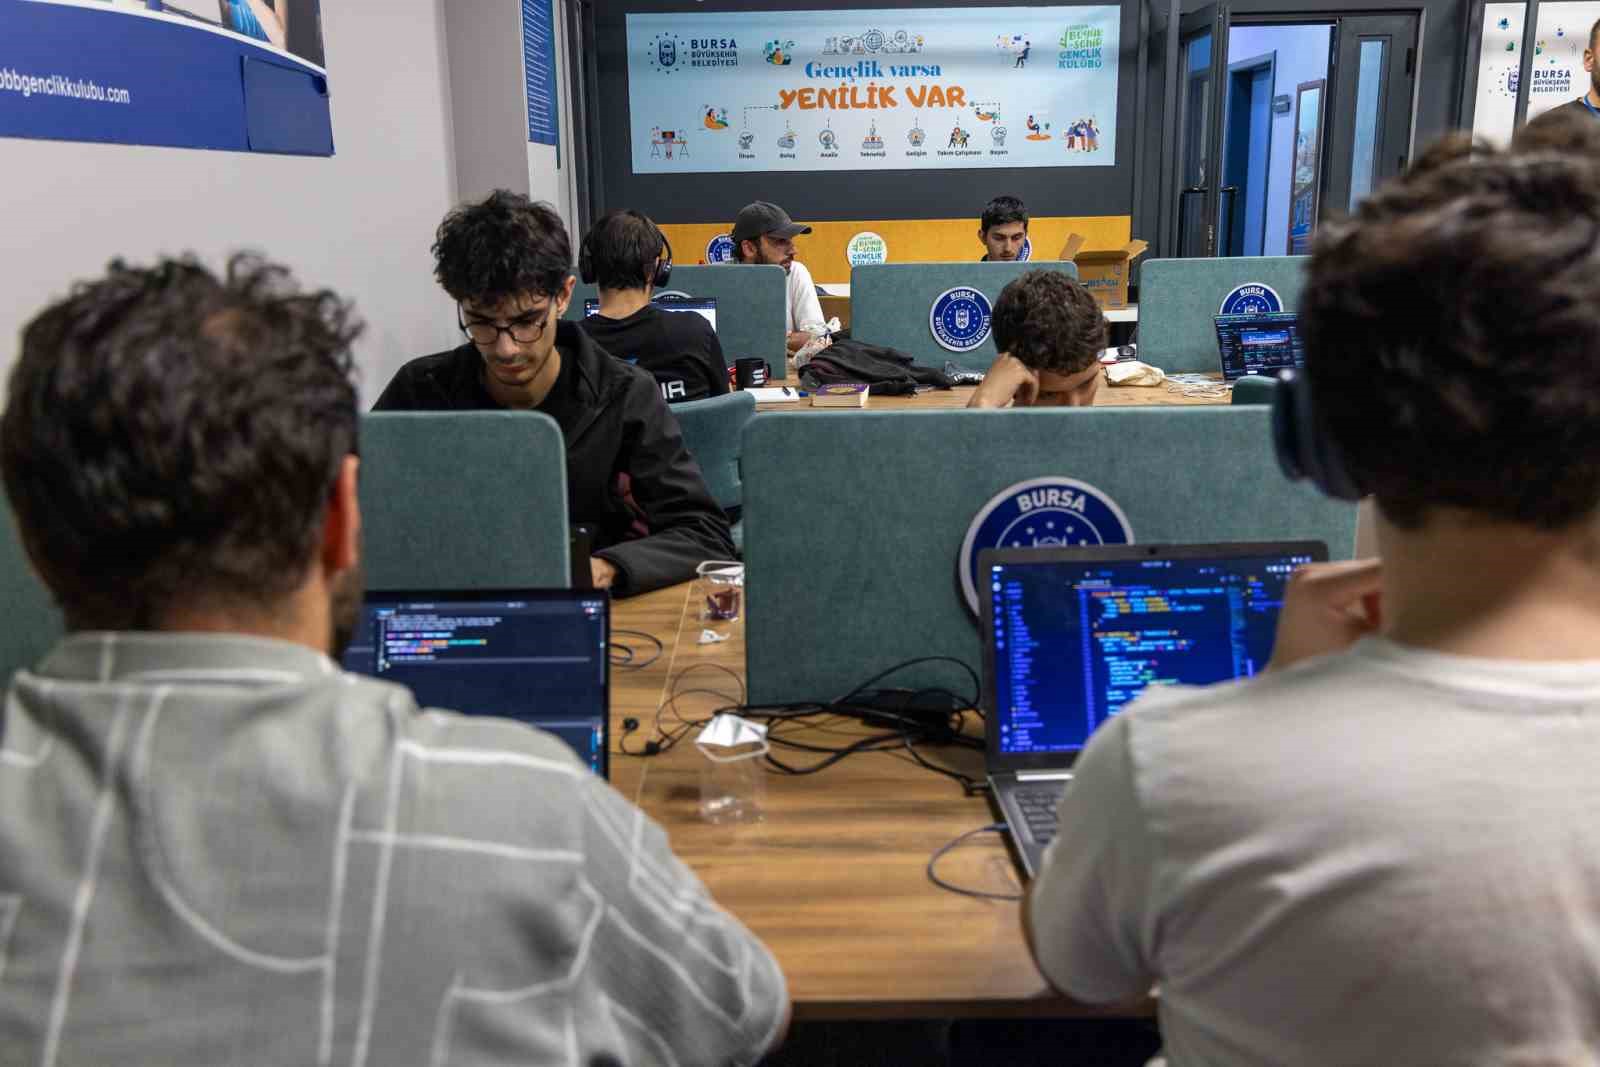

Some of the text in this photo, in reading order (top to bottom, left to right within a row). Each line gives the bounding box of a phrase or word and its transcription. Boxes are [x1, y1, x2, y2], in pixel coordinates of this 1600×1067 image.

[691, 39, 737, 49] BURSA
[691, 50, 737, 59] BÜYÜKŞEHİR
[691, 58, 737, 67] BELEDİYESİ
[805, 61, 941, 82] Gençlik varsa
[1534, 69, 1571, 79] BURSA
[779, 82, 967, 109] YENİLİK VAR
[951, 291, 975, 301] BURSA
[1239, 287, 1265, 297] BURSA
[1017, 489, 1086, 512] BURSA
